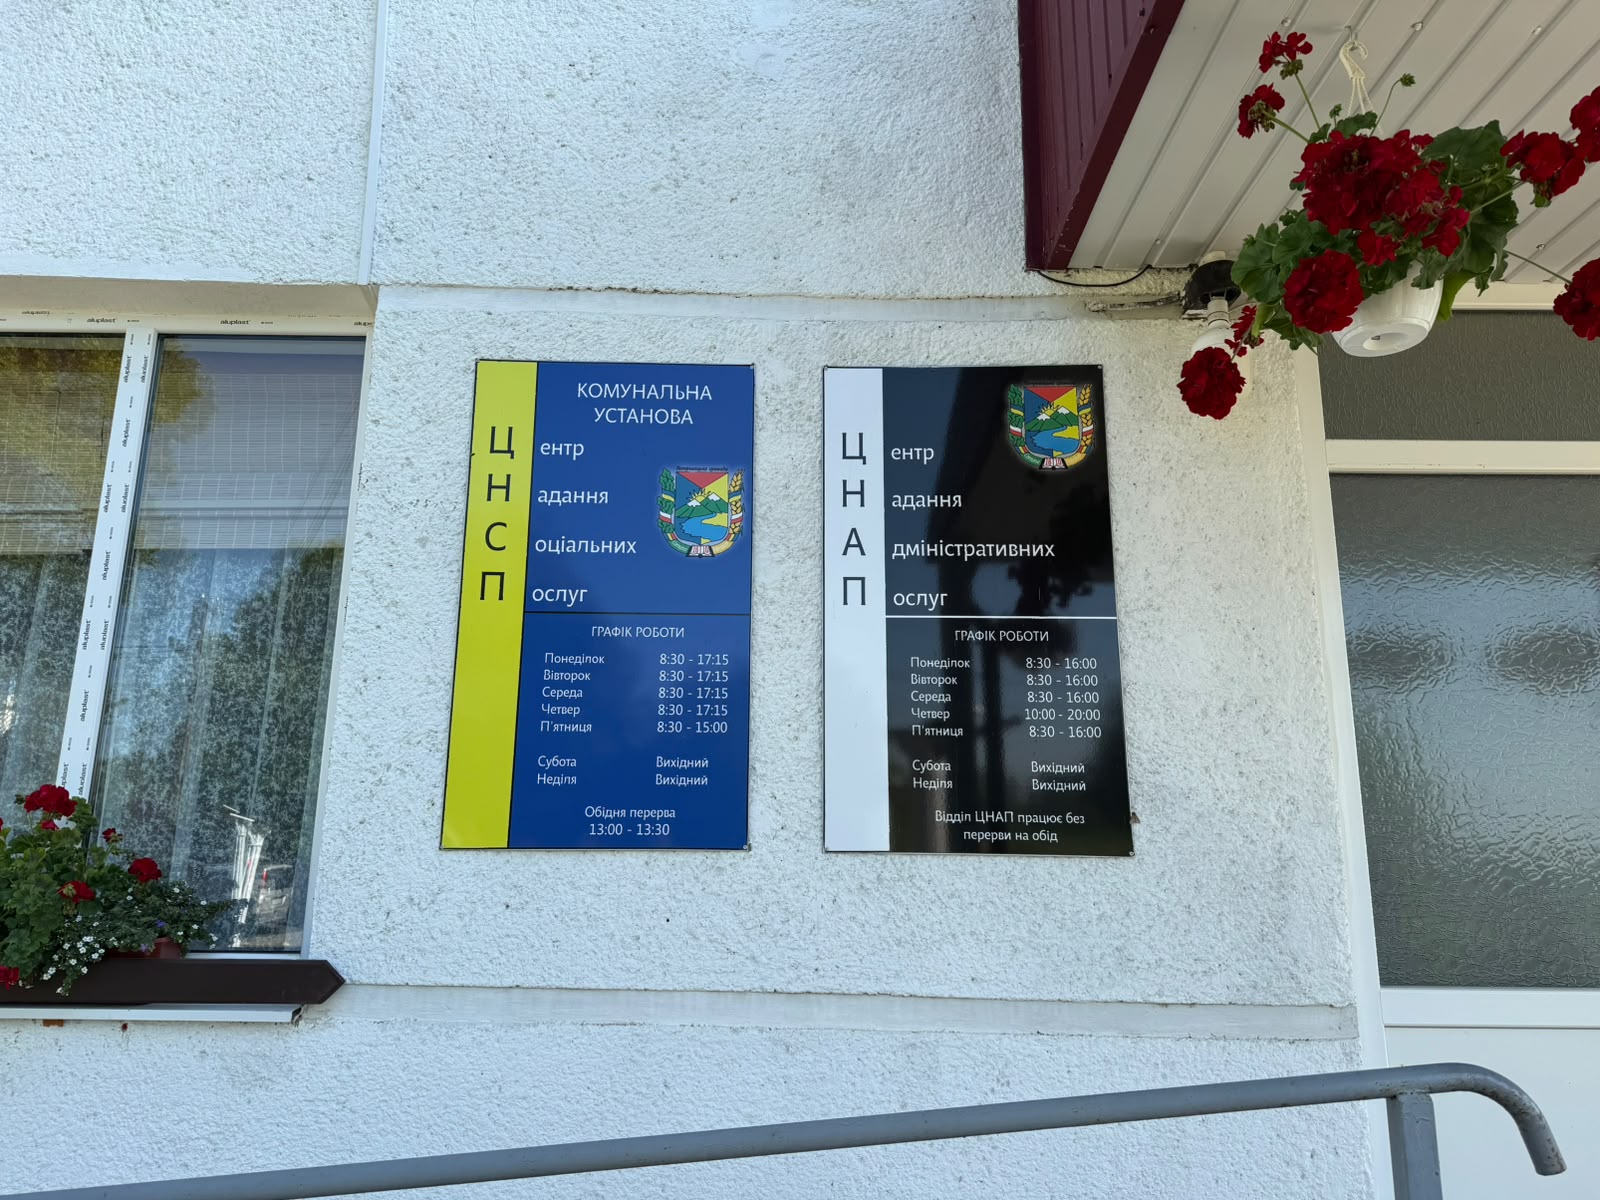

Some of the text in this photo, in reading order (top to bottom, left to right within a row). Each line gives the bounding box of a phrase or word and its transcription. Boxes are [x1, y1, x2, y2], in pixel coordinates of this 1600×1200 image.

[578, 383, 712, 400] КОМУНАЛЬНА
[595, 408, 693, 424] УСТАНОВА
[490, 426, 584, 460] Ц ентр
[842, 433, 934, 465] Ц ентр
[487, 474, 608, 506] Н адання
[843, 480, 961, 510] Н адання
[485, 522, 636, 554] С оціальних
[842, 528, 1054, 561] А дміністративних
[480, 572, 587, 607] П ослуг
[843, 577, 947, 611] П ослуг
[592, 627, 684, 637] ГРАФІК РОБОТИ
[955, 631, 1048, 641] ГРАФІК РОБОТИ
[545, 653, 604, 665] Понеділок
[660, 654, 684, 664] 8:30
[698, 654, 728, 665] 17:15
[911, 657, 969, 669] Понеділок
[1026, 658, 1051, 669] 8:30
[1065, 658, 1097, 669] 16:00
[544, 669, 590, 683] Вівторок
[659, 670, 684, 681] 8:30
[698, 671, 728, 682] 17:15
[911, 674, 957, 687] Вівторок
[1027, 674, 1051, 685] 8:30
[1066, 675, 1098, 686] 16:00
[543, 687, 582, 700] Середа
[659, 687, 683, 698] 8:30
[697, 688, 728, 699] 17:15
[911, 691, 951, 704] Середа
[1028, 692, 1052, 702] 8:30
[1067, 692, 1099, 703] 16:00
[542, 704, 580, 717] Четвер
[658, 704, 683, 715] 8:30
[697, 705, 727, 716] 17:15
[912, 708, 949, 721] Четвер
[1025, 708, 1055, 720] 10:00
[1068, 709, 1100, 720] 20:00
[541, 721, 591, 732] П'ятниця
[657, 721, 682, 732] 8:30
[696, 722, 727, 733] 15:00
[912, 725, 963, 737] П'ятниця
[1030, 726, 1054, 737] 8:30
[1069, 726, 1101, 737] 16:00
[538, 755, 576, 769] Субота
[657, 756, 708, 769] Вихідний
[913, 760, 951, 773] Субота
[1032, 761, 1084, 774] Вихідний
[537, 773, 576, 786] Неділя
[656, 774, 707, 786] Вихідний
[914, 777, 952, 790] Неділя
[1032, 779, 1085, 792] Вихідний
[585, 806, 675, 820] Обідня перерва
[936, 810, 1084, 825] Відділ ЦНАП працює без
[590, 824, 622, 835] 13:00
[637, 824, 669, 835] 13:30
[964, 832, 1011, 843] перерви
[1033, 830, 1058, 842] обід
